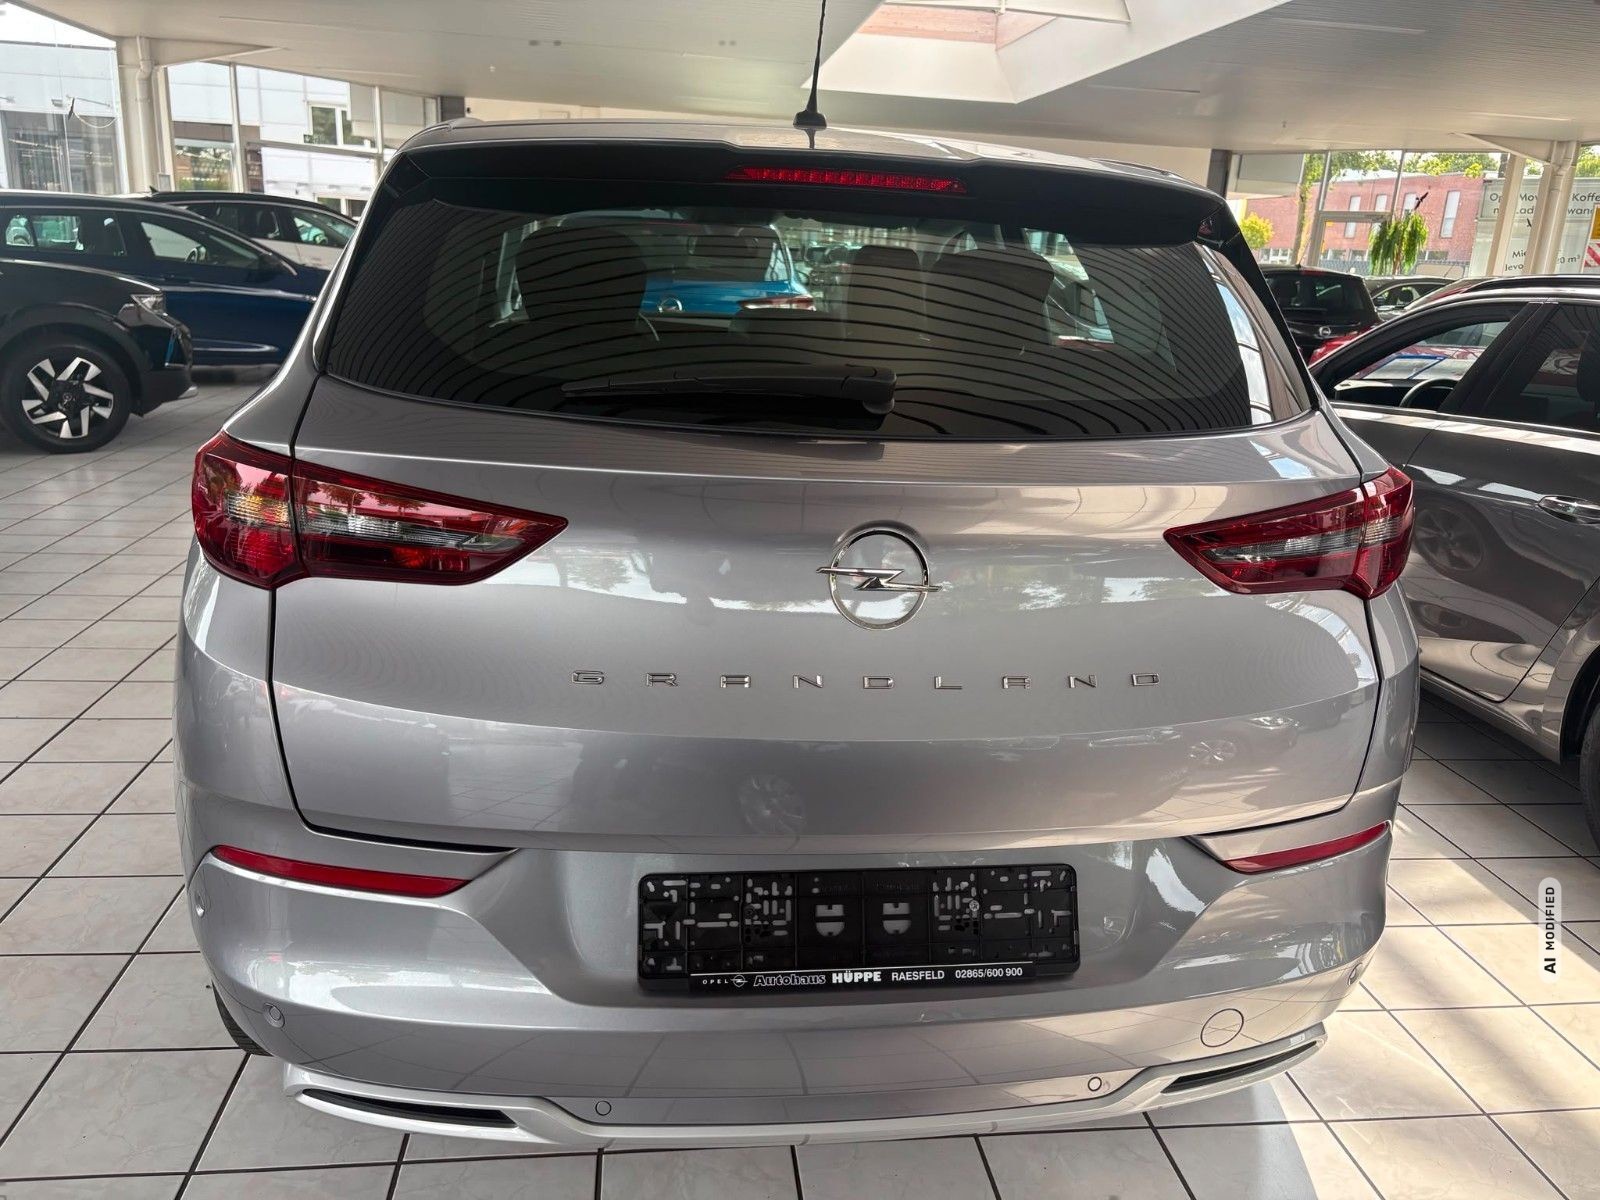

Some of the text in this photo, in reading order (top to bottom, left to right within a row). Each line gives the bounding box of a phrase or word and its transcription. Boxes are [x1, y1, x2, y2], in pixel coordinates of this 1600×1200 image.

[571, 669, 1162, 690] GRANDLAND
[702, 967, 1023, 987] OPEL Autohaus HÜPPE RAESFELD 02865/600 900
